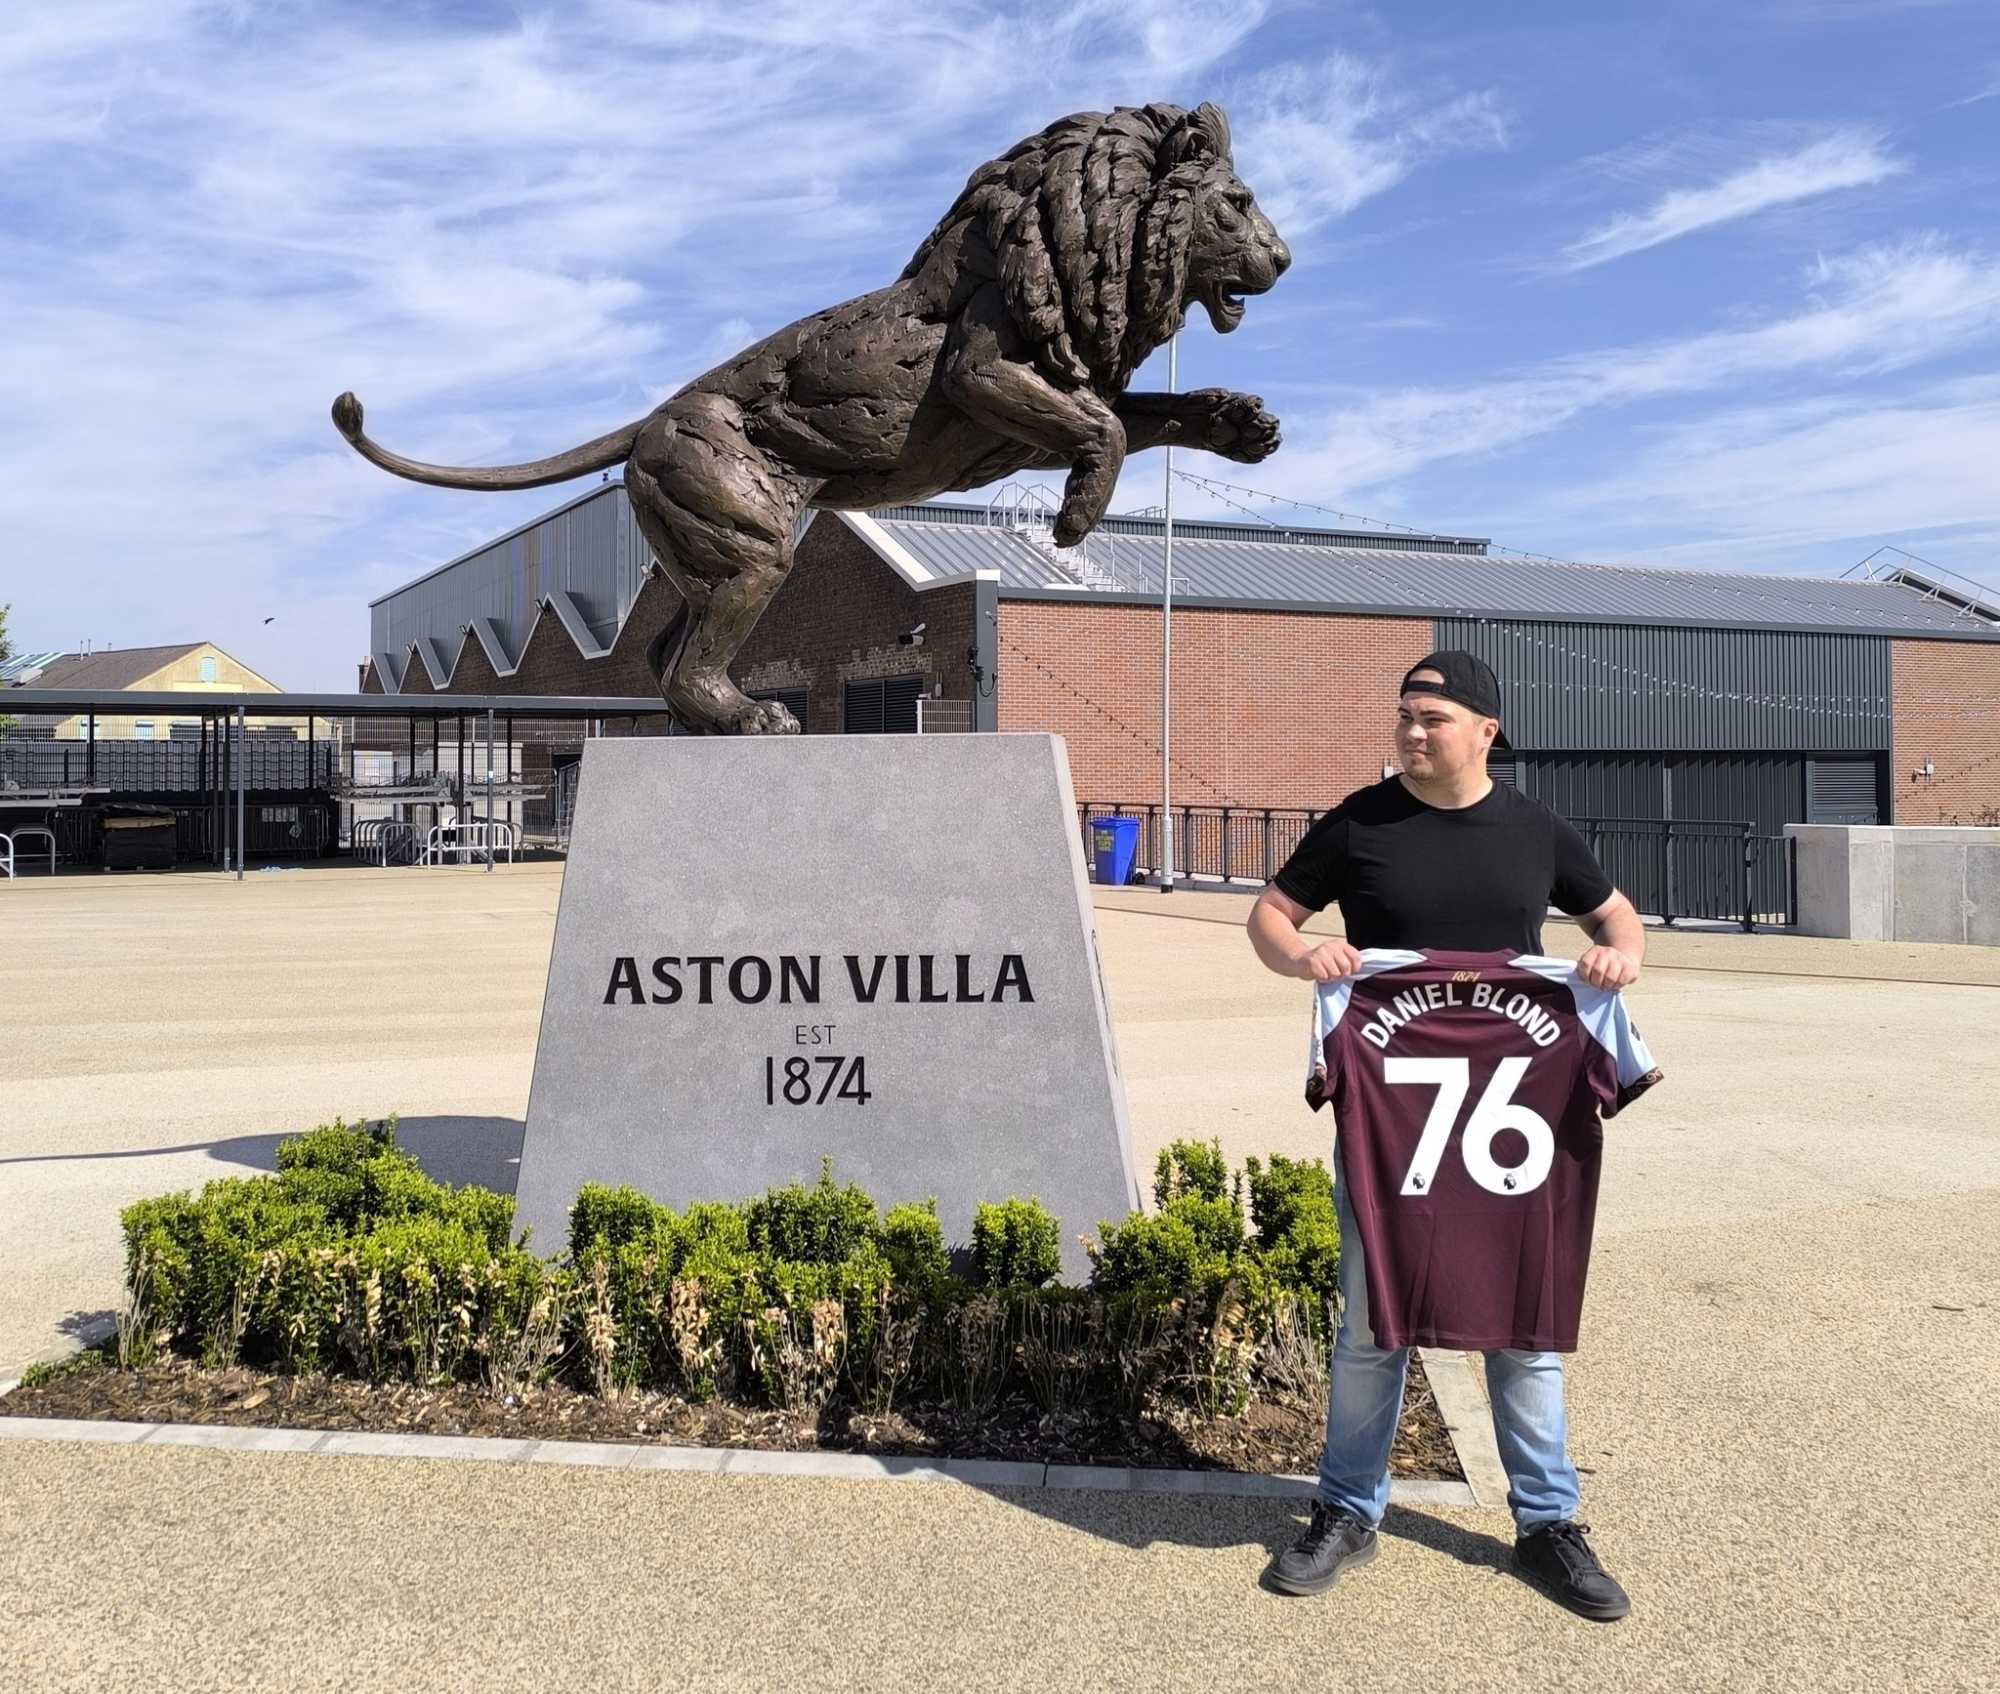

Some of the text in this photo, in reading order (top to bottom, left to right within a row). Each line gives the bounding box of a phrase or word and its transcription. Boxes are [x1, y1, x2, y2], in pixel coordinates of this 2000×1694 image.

[603, 954, 1035, 1005] ASTON VILLA
[1451, 970, 1481, 982] 1874
[796, 1025, 836, 1045] EST
[1361, 983, 1560, 1049] DANIEL BLOND
[766, 1056, 872, 1106] 1874
[1384, 1057, 1555, 1195] 76
